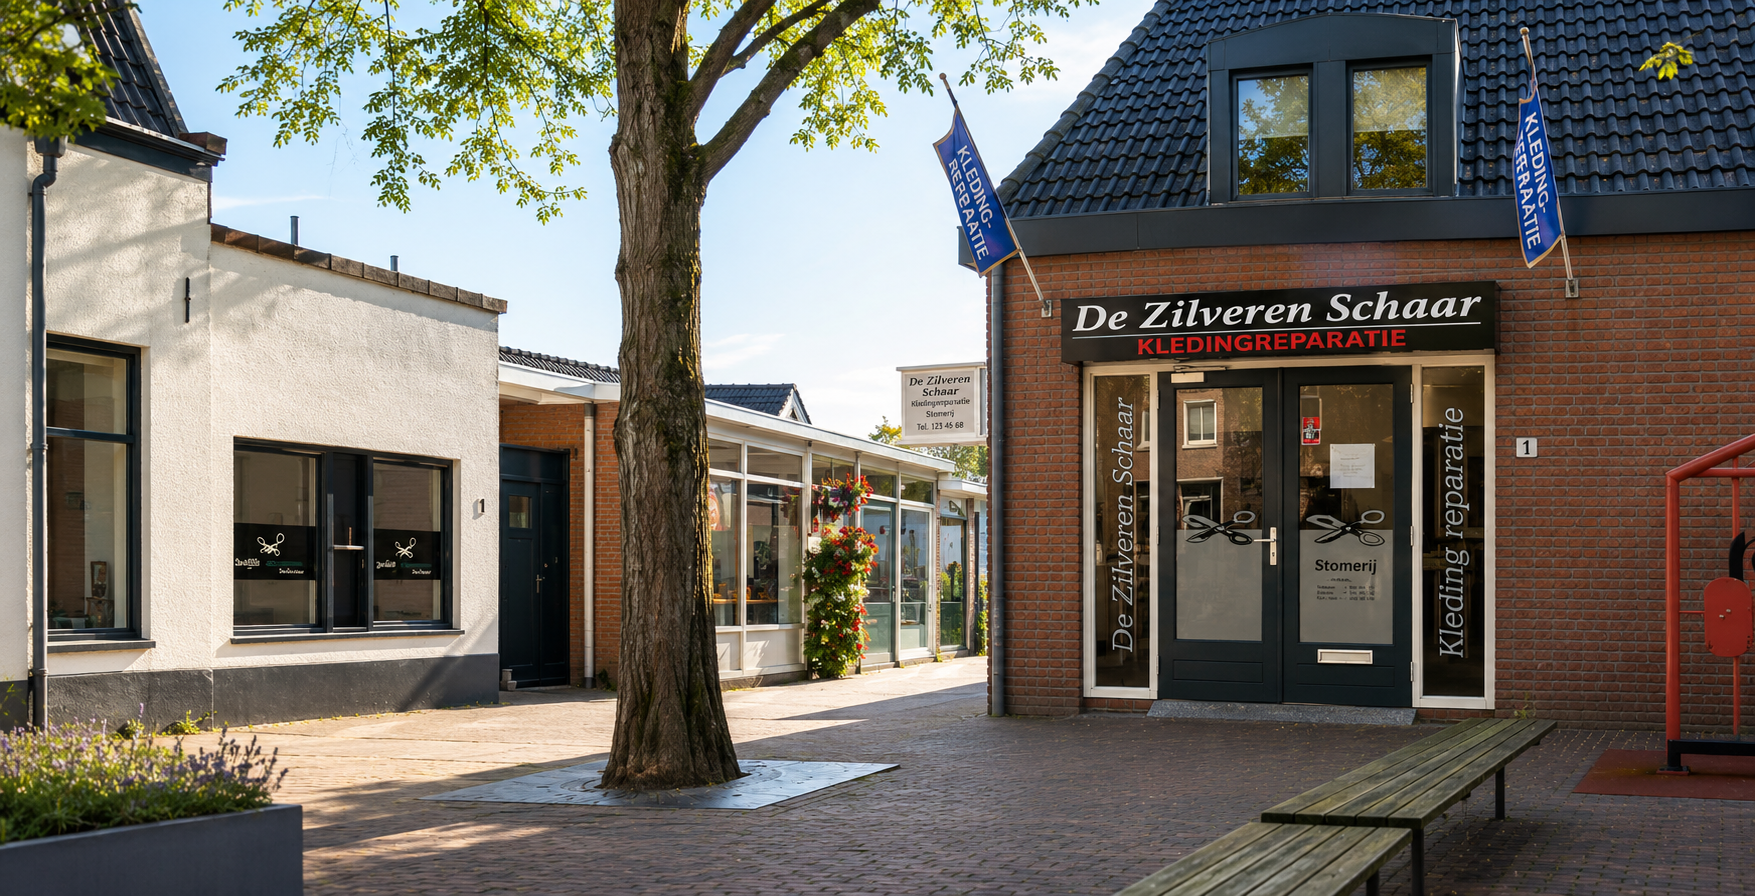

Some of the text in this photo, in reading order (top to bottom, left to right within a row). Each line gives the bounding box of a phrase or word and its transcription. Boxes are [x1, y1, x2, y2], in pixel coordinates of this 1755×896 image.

[957, 145, 993, 229] KLEDING-
[1072, 291, 1482, 332] De Zilveren Schaar
[1137, 329, 1407, 355] KLEDINGREPARATIE
[909, 375, 971, 386] De Zilveren
[922, 387, 959, 397] Schaar
[1522, 439, 1530, 455] 1
[1111, 397, 1133, 653] De Zilveren Schaar
[1438, 407, 1470, 658] Kleding reparatie
[1315, 559, 1377, 576] Stomerij
